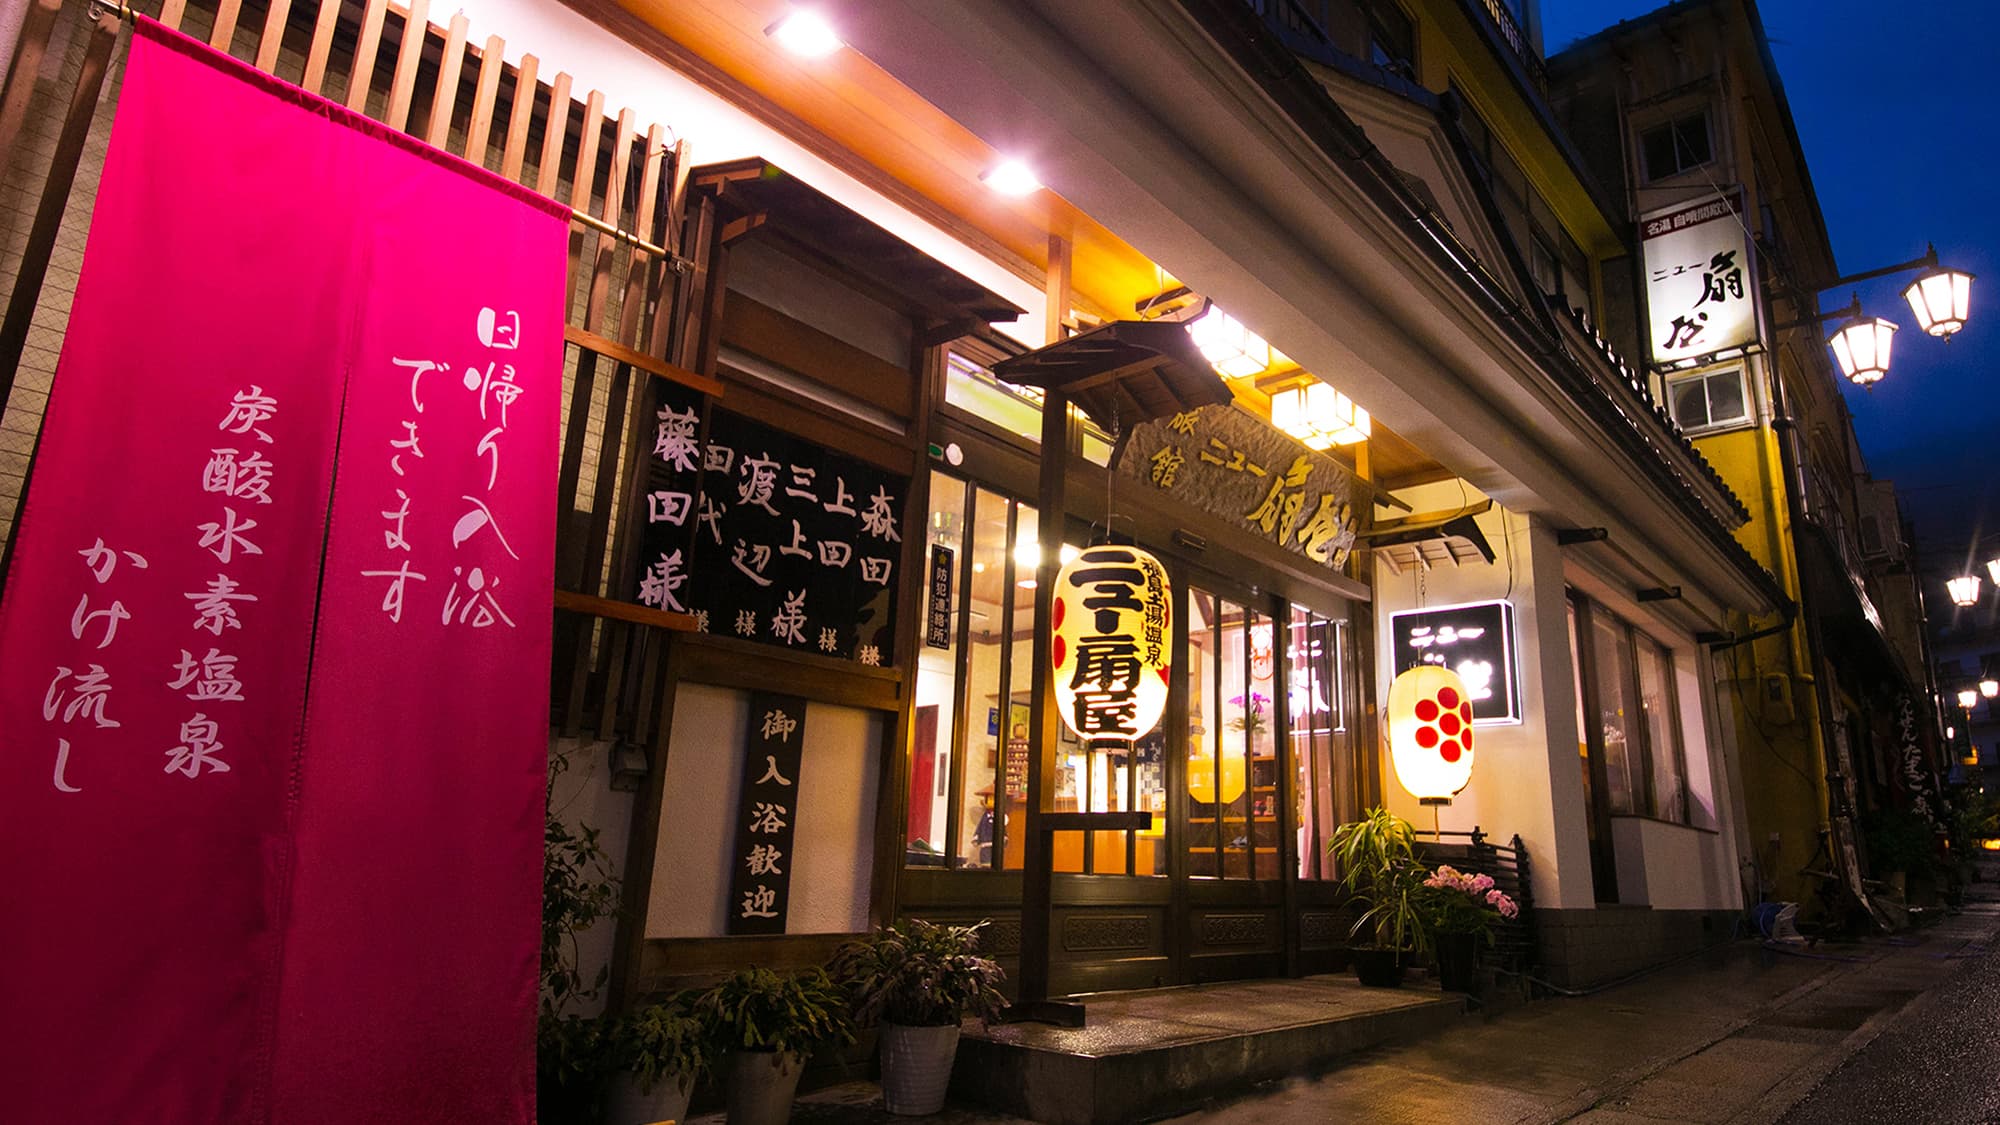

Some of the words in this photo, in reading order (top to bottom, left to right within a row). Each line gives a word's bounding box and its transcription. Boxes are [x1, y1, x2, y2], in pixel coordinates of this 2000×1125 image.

[164, 384, 278, 779] 炭酸水素塩泉
[361, 356, 450, 622] できます
[442, 306, 524, 627] 日帰り入浴
[637, 403, 700, 613] 藤田様
[43, 537, 149, 793] かけ流し
[933, 567, 948, 643] 防犯連絡所
[1069, 550, 1146, 736] ニュー扇屋
[740, 709, 797, 919] 御入浴歓迎
